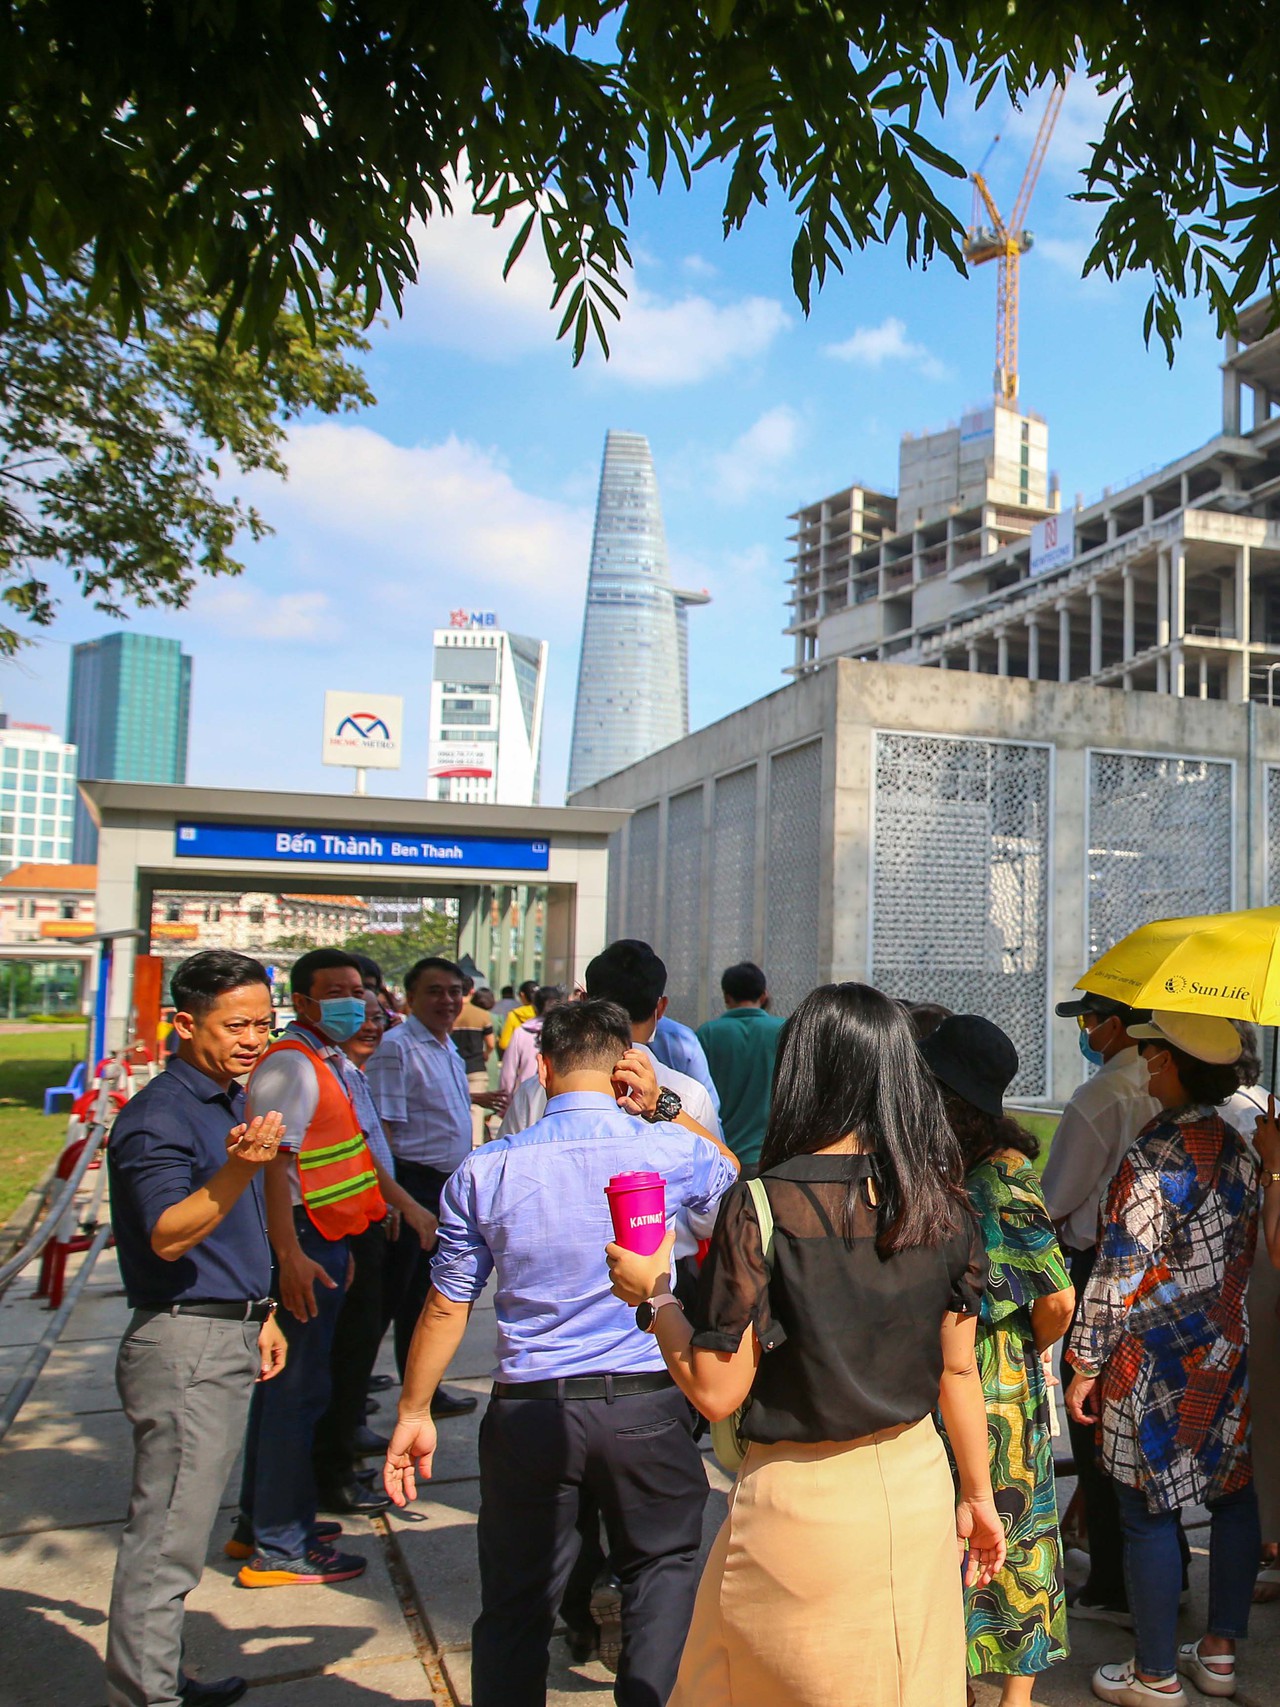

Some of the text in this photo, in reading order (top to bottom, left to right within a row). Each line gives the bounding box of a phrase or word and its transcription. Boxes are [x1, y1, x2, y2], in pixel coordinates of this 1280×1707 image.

[362, 740, 395, 749] METRO
[275, 832, 463, 859] Bến Thành Ben Thanh
[1188, 981, 1250, 1001] Sun Life
[630, 1211, 663, 1229] KATINAT
